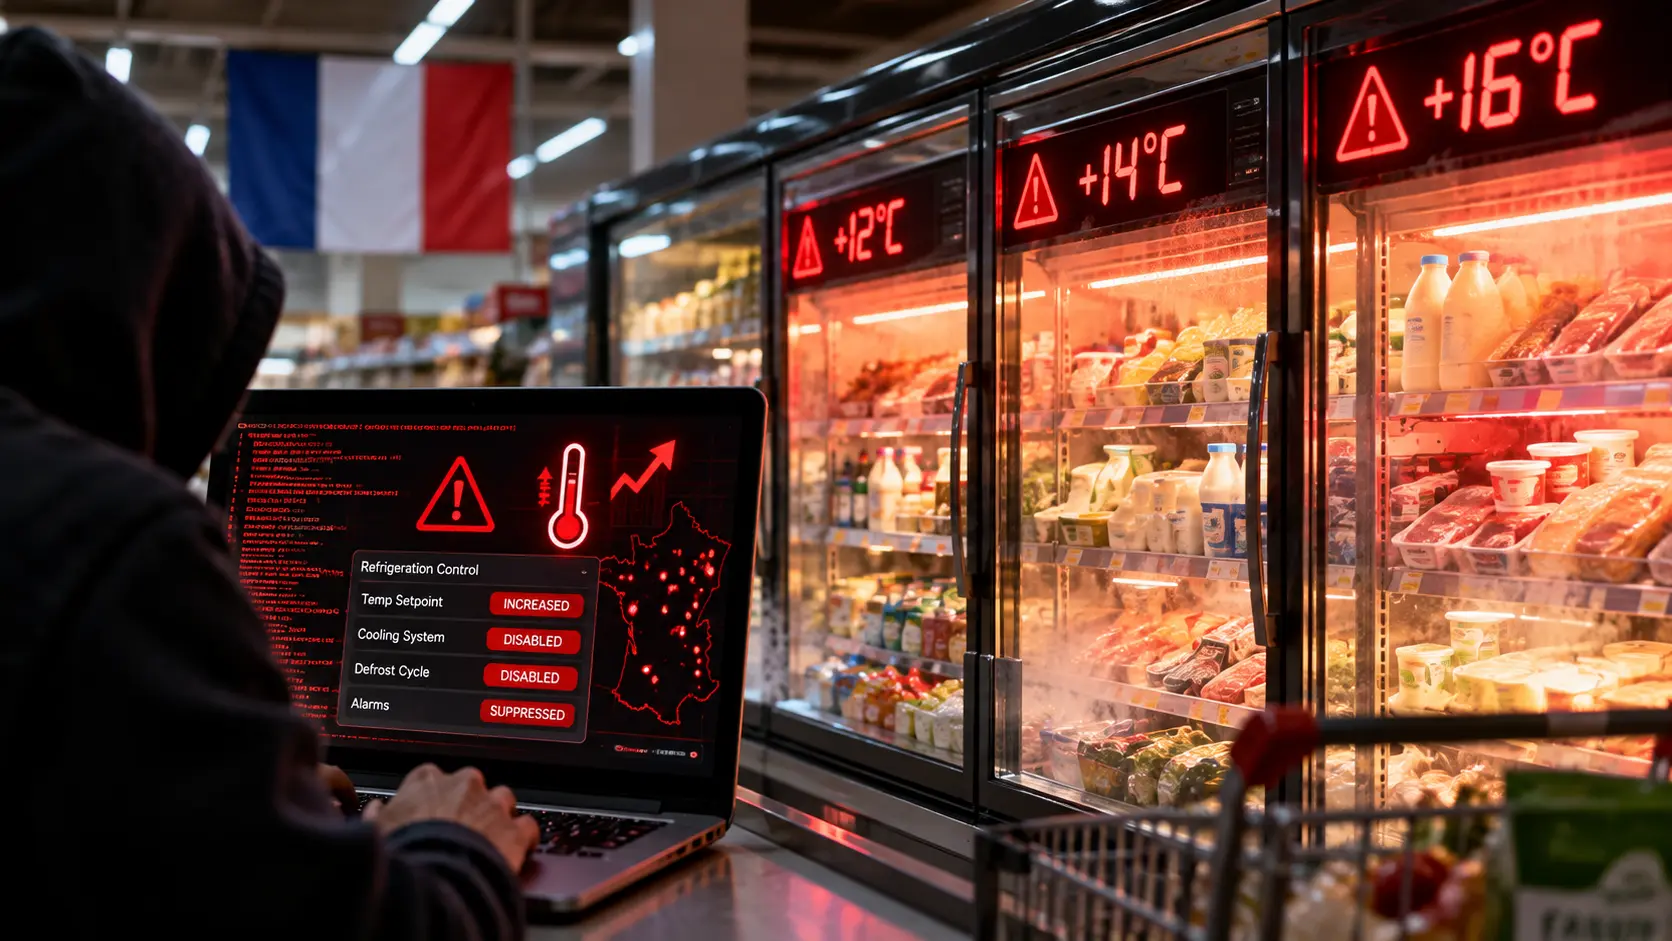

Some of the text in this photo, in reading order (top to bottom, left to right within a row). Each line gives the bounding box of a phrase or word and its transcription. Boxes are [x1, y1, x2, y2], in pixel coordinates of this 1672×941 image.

[1424, 19, 1603, 133] +16°C
[1079, 124, 1188, 206] +14°C
[834, 197, 906, 262] +12°C
[360, 560, 479, 579] Refrigeration Control
[361, 593, 444, 611] Temp Setpoint
[503, 597, 570, 613] INCREASED
[357, 627, 445, 646] Cooling System
[503, 633, 563, 649] DISABLED
[354, 662, 430, 681] Defrost Cycle
[500, 669, 560, 685] DISABLED
[351, 697, 390, 713] Alarms
[489, 704, 566, 721] SUPPRESSED
